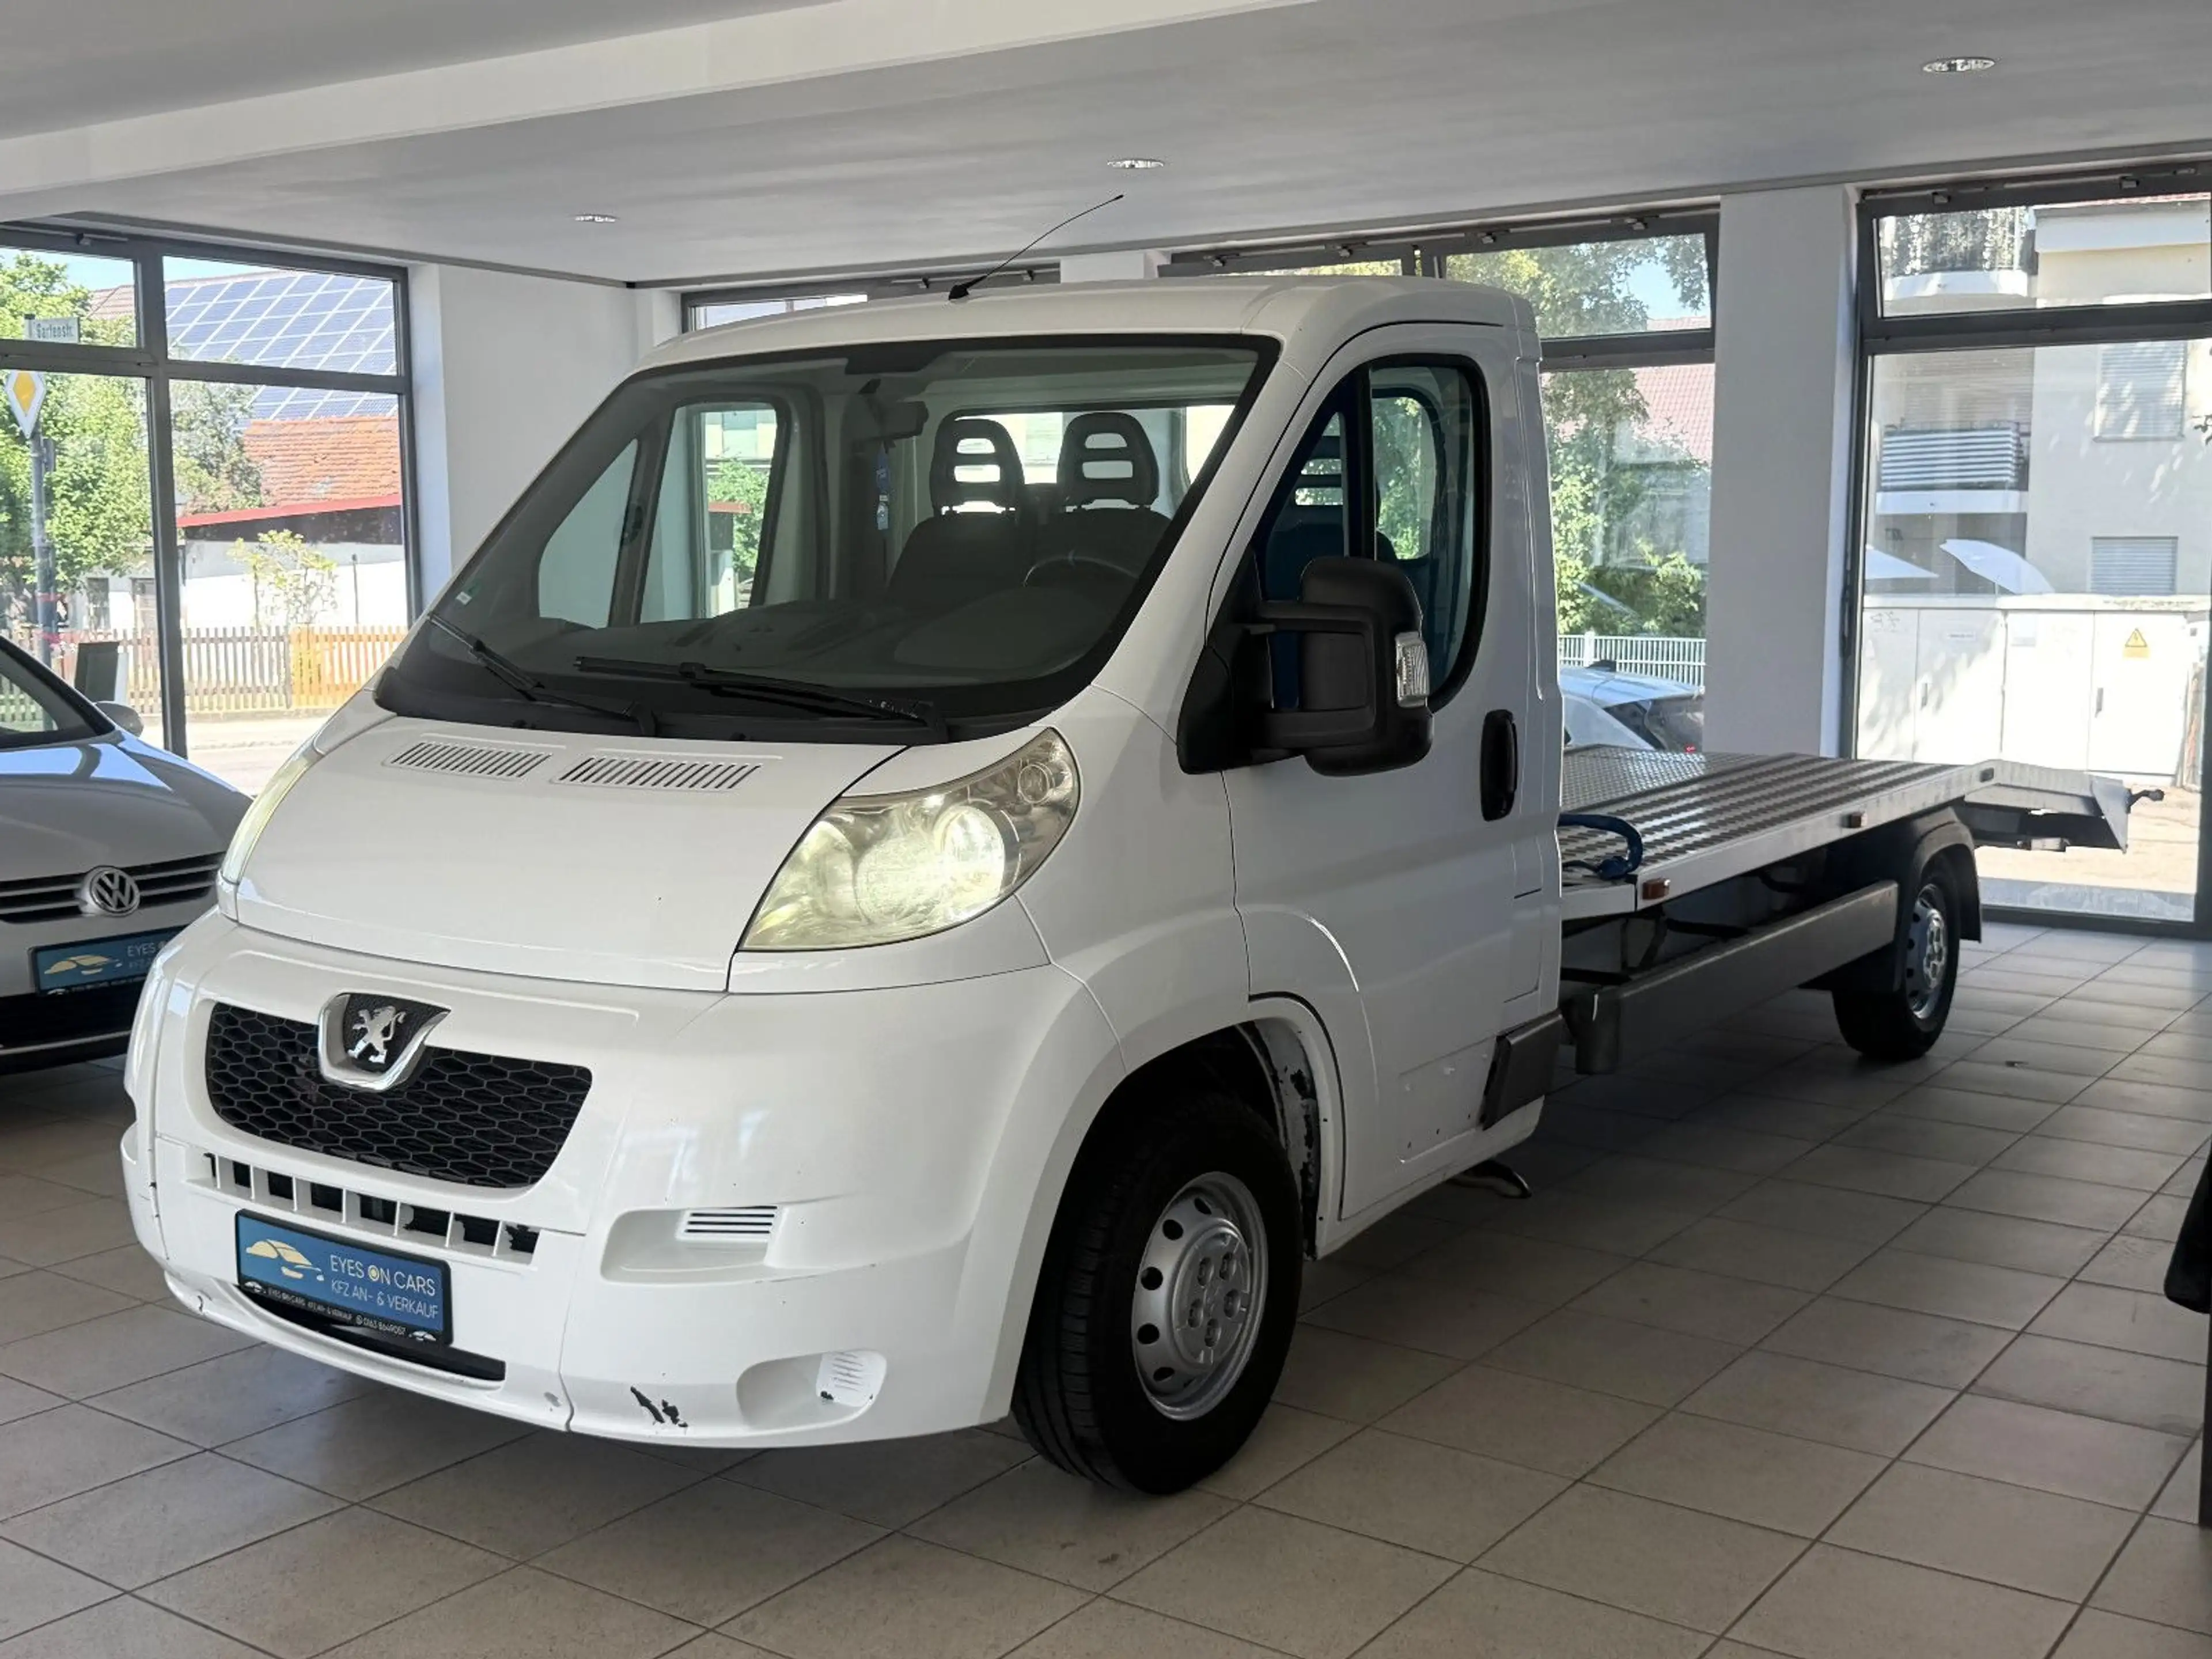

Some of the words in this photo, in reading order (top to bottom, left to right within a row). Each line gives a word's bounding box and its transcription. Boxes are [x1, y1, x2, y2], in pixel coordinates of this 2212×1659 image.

[127, 942, 156, 956] EYES
[329, 1254, 365, 1279] EYES
[368, 1264, 391, 1285] ON
[394, 1271, 435, 1297] CARS
[331, 1279, 350, 1297] KFZ
[352, 1285, 374, 1302] AN-
[376, 1291, 385, 1306] &
[387, 1294, 439, 1319] VERKAUF
